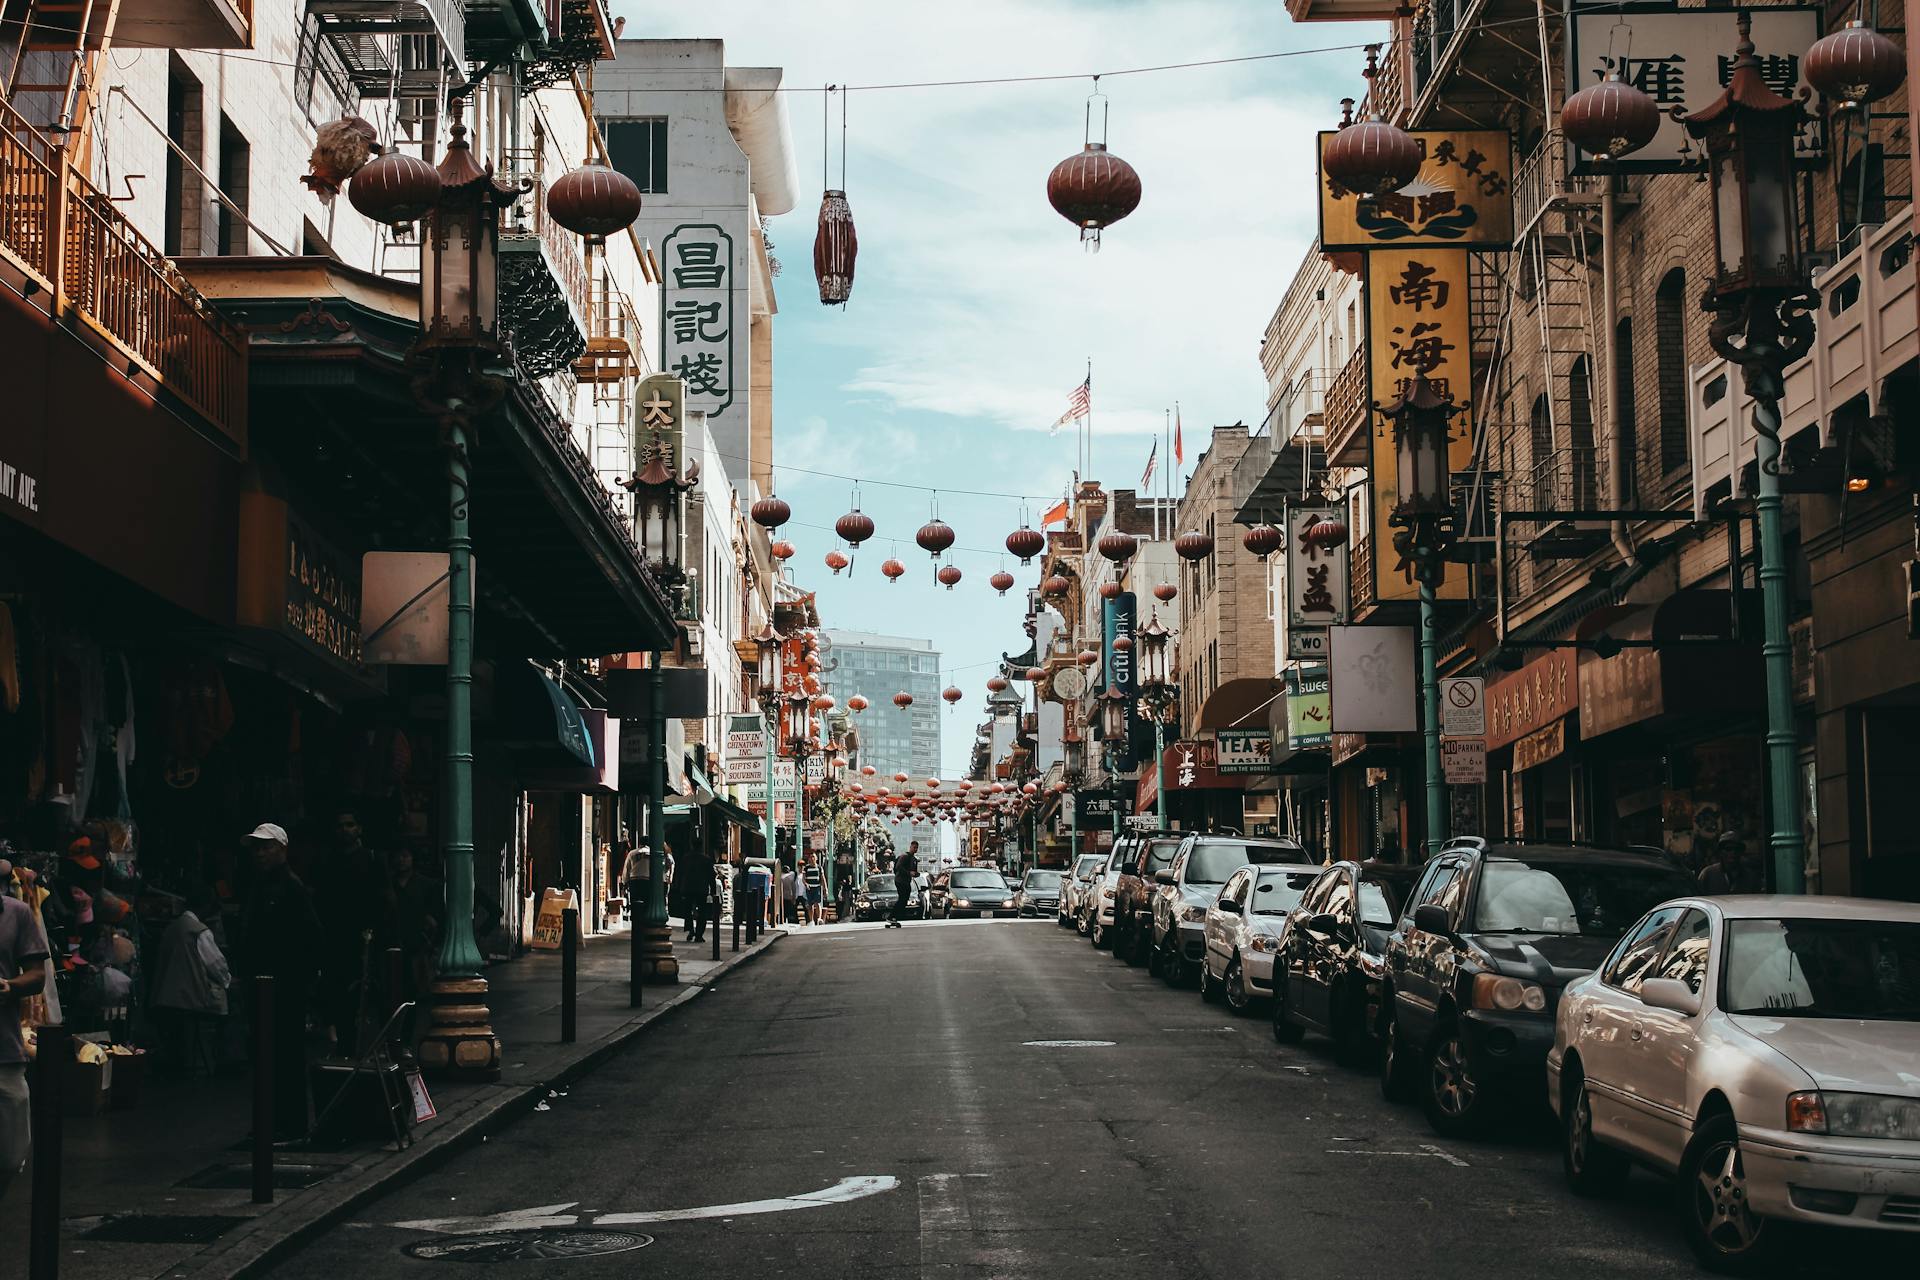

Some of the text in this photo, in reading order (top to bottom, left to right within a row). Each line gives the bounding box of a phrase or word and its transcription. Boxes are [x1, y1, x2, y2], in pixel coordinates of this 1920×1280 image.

[0, 460, 38, 512] NT AVE.
[1301, 638, 1321, 649] WO
[730, 733, 760, 742] ONLY IN
[727, 741, 764, 749] CHINATOWN
[1218, 737, 1253, 753] TEA
[1445, 741, 1484, 753] NO PARKING
[729, 762, 752, 770] GIFTS
[1176, 750, 1196, 787] 上海
[728, 771, 762, 780] SOUVENIR
